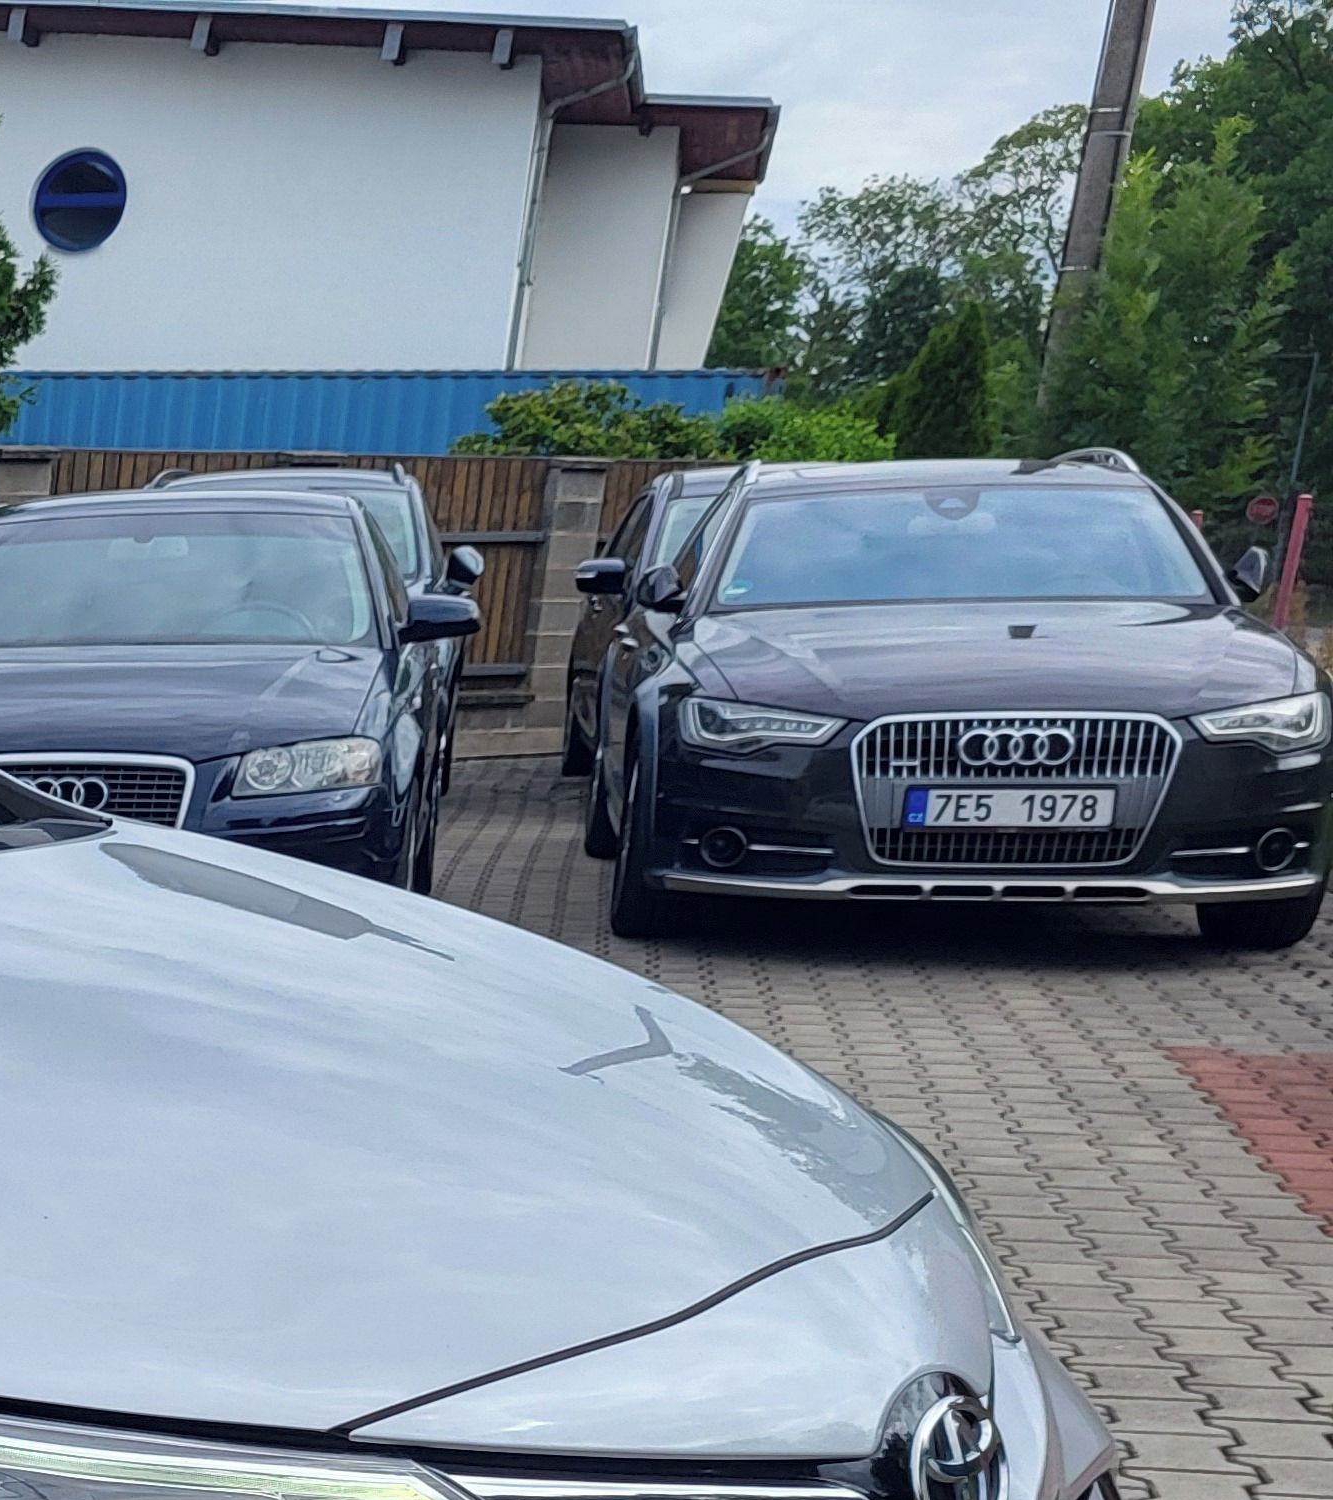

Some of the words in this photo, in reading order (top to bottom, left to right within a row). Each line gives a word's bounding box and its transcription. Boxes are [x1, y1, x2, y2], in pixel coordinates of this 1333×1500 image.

[908, 812, 924, 823] CZ
[933, 794, 994, 822] 7E5
[1021, 794, 1099, 822] 1978
